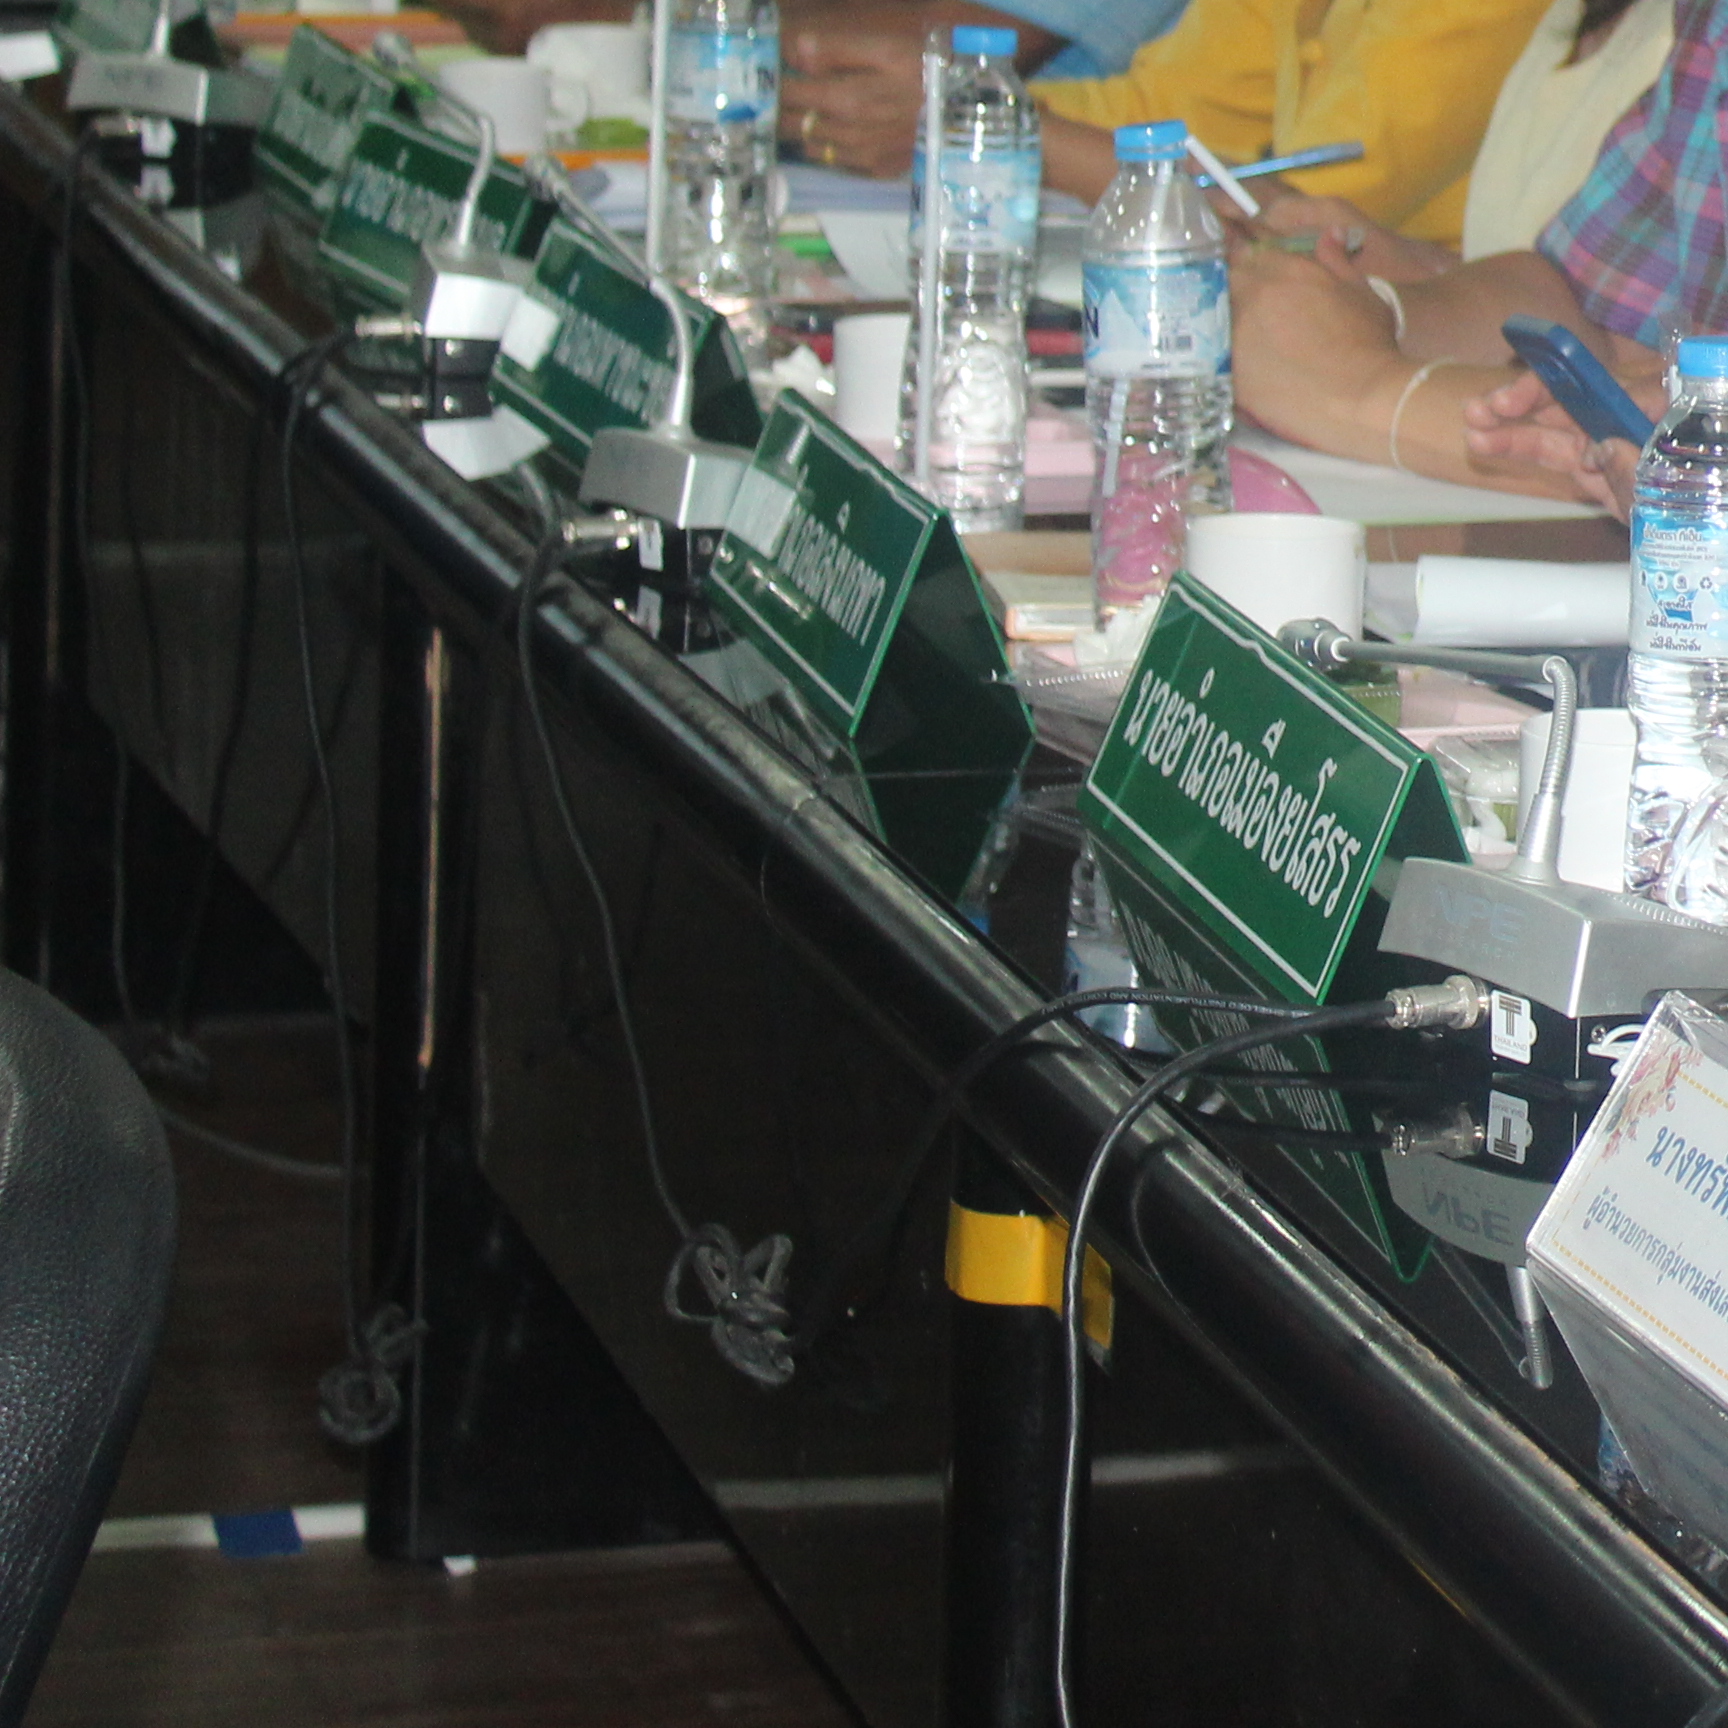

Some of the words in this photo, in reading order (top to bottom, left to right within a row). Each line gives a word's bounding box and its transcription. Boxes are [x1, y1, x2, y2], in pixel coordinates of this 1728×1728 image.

[1123, 667, 1361, 918] นายอำเภอเมืองยโสธร
